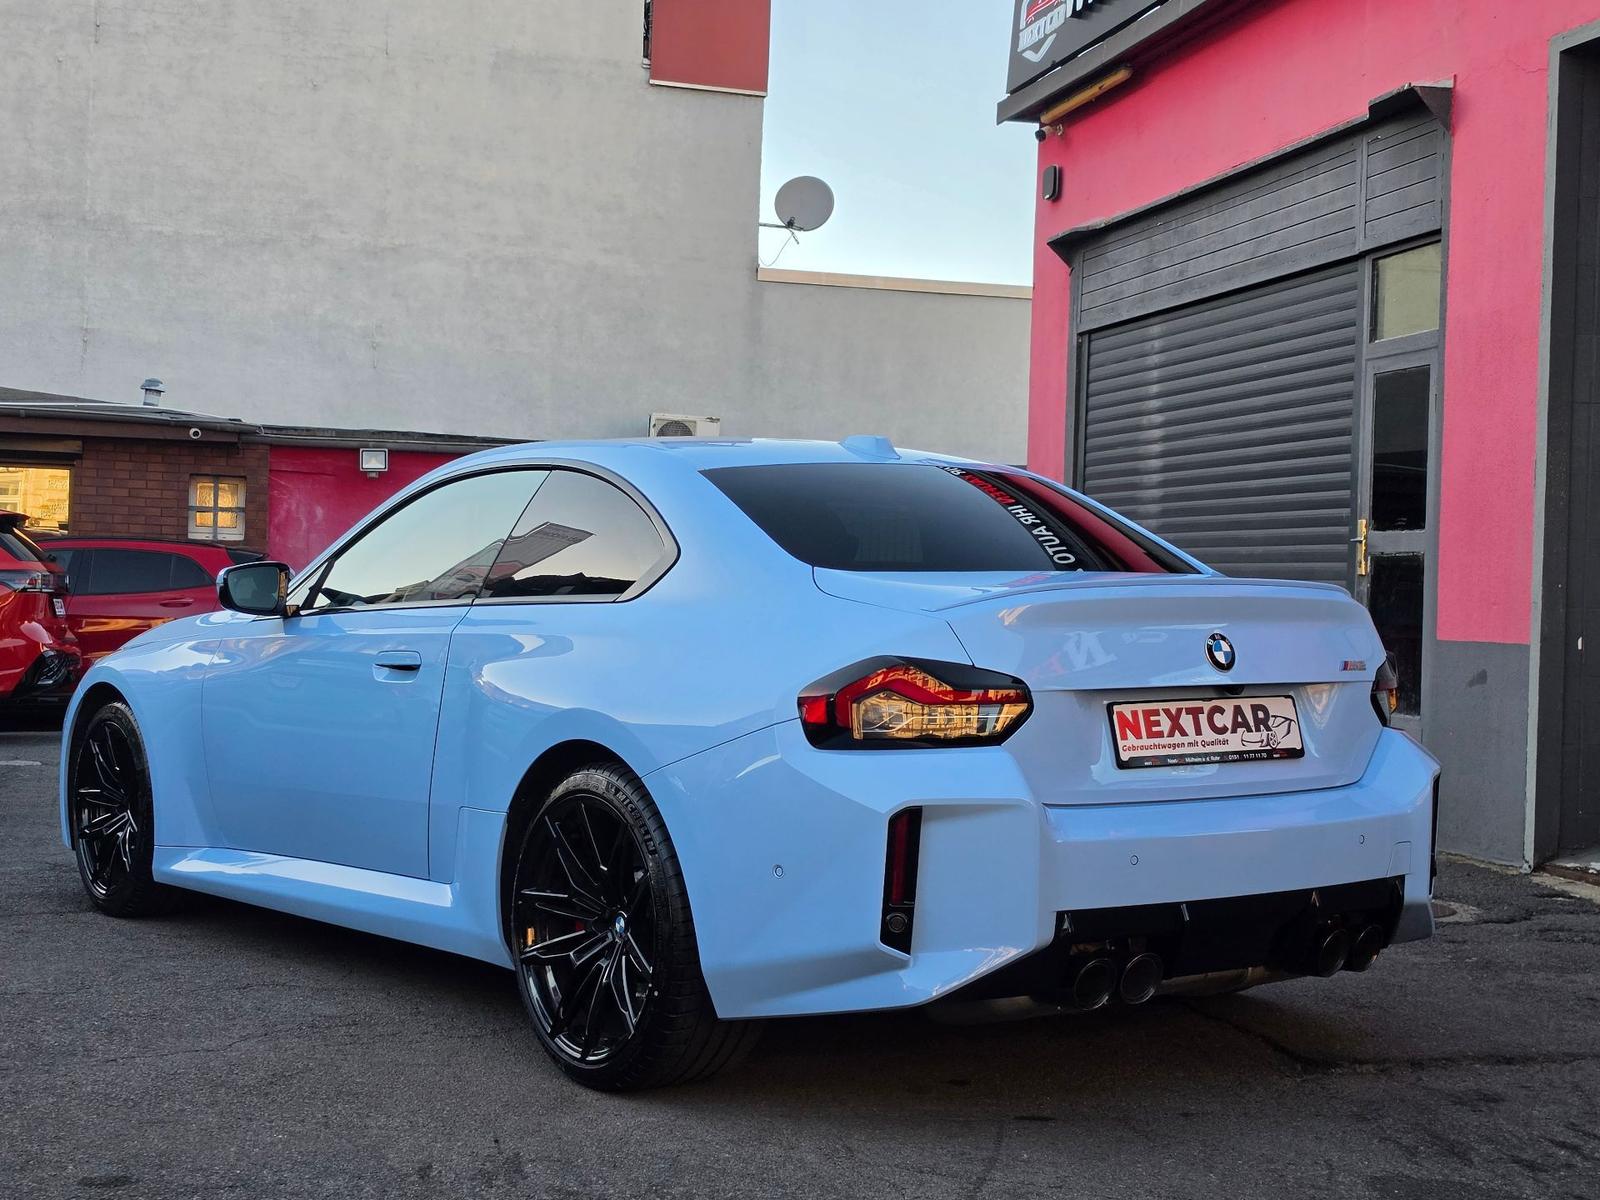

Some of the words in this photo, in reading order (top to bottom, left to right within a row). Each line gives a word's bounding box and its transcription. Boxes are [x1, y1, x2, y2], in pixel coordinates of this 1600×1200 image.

[1116, 704, 1273, 741] NEXTCAR
[1121, 743, 1187, 752] Gebrauchtwagen
[1187, 740, 1199, 748] mit
[1200, 739, 1229, 748] Qualität
[616, 791, 658, 855] MICHELIN
